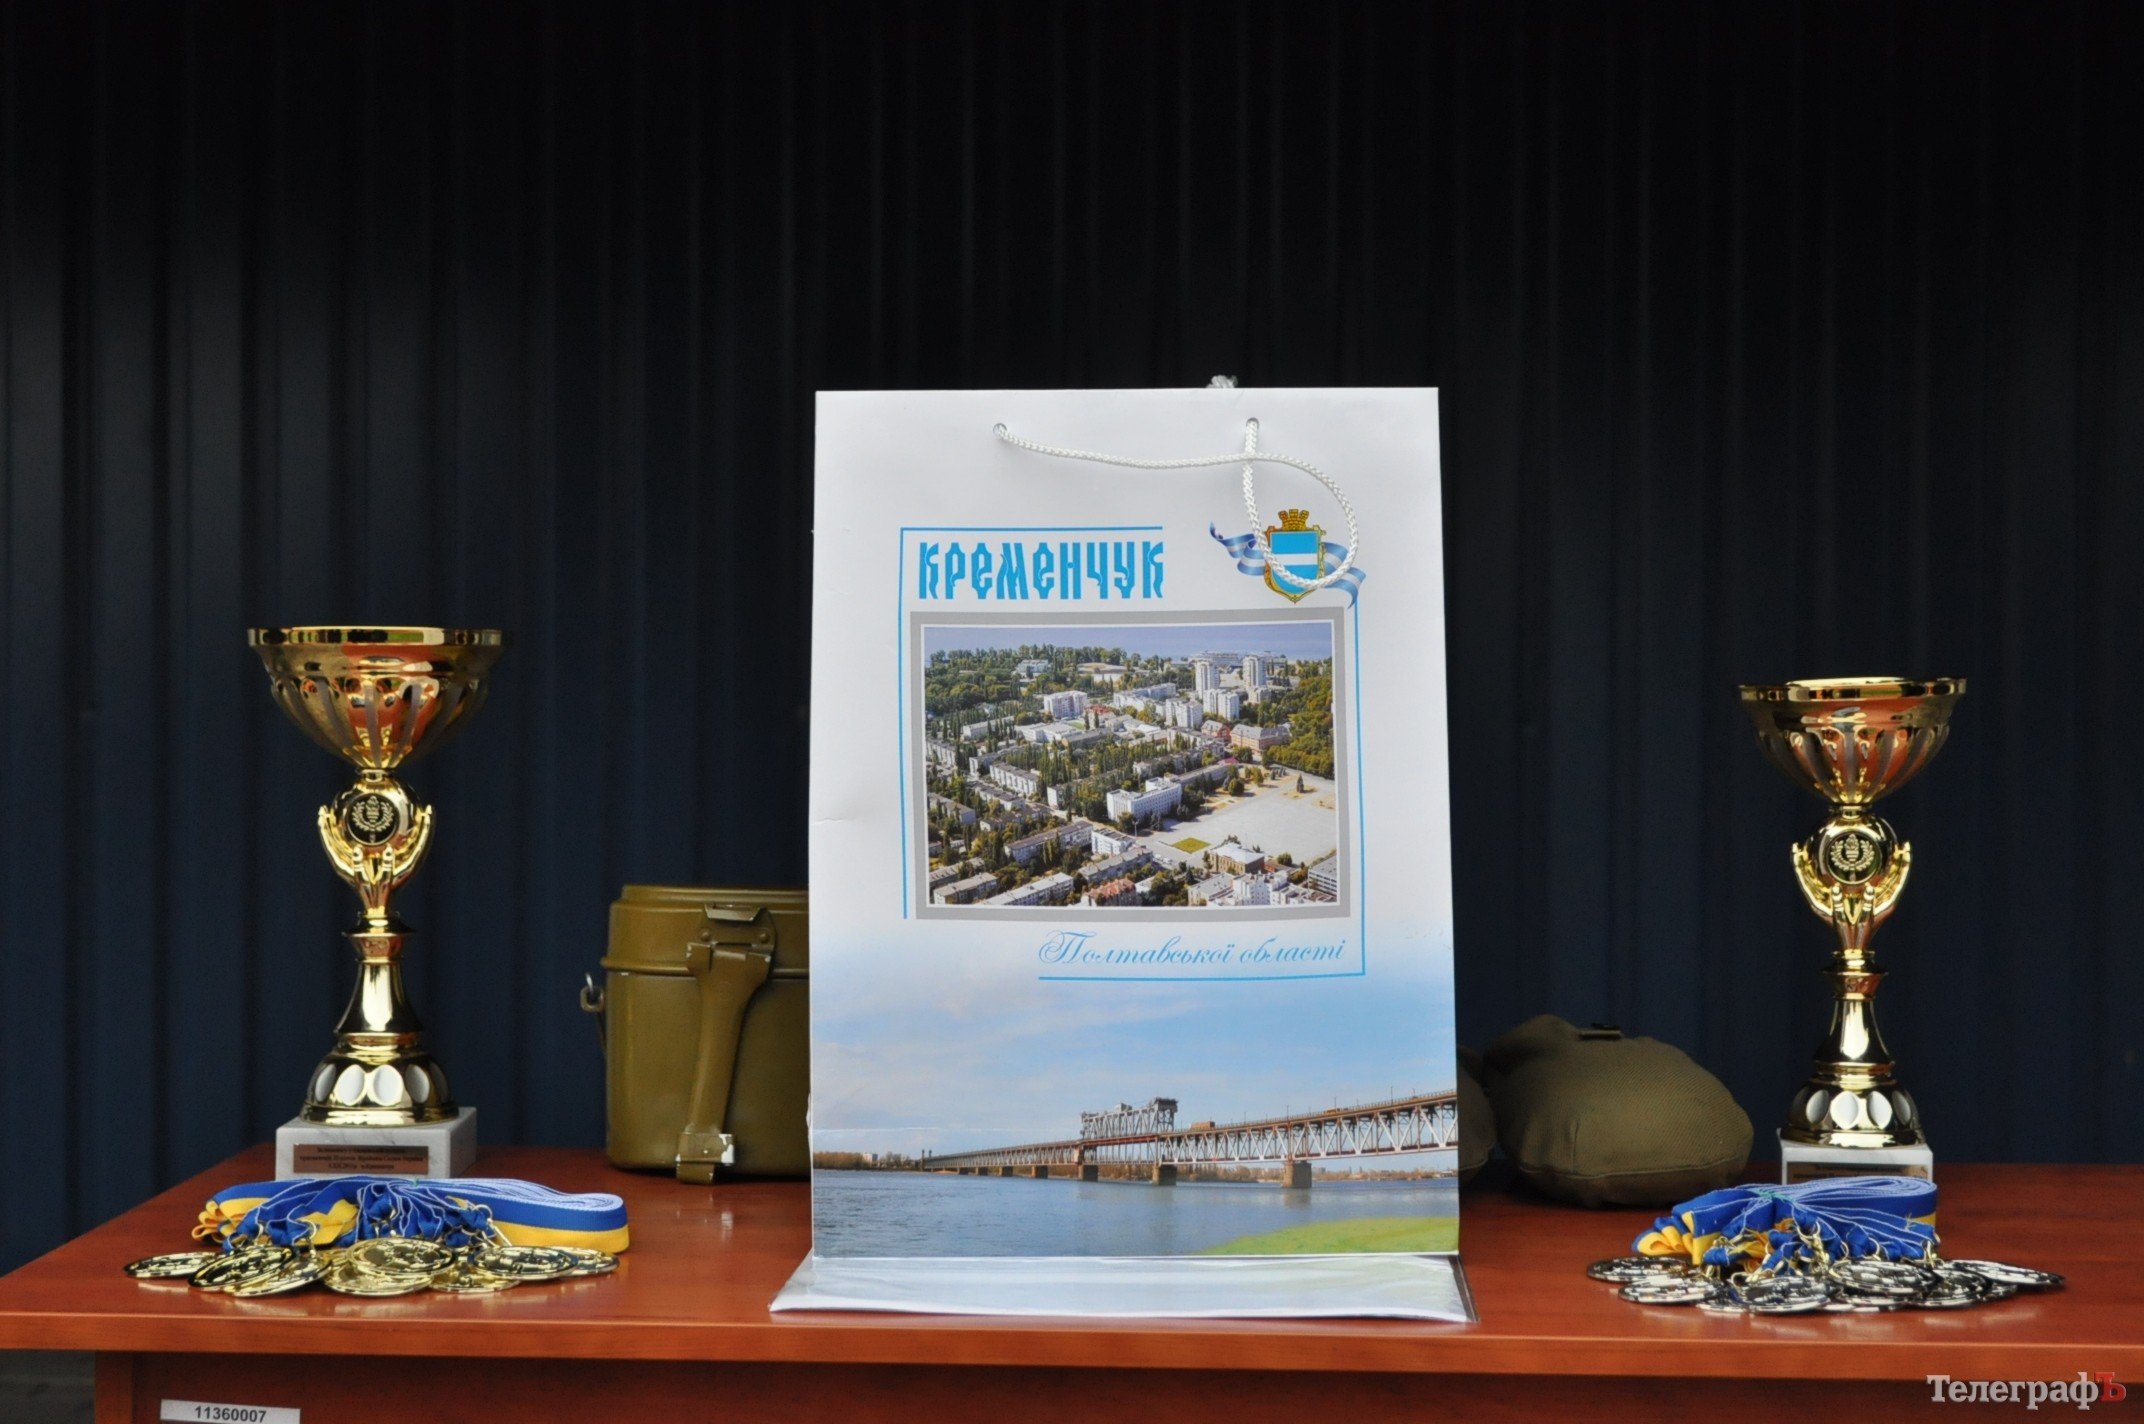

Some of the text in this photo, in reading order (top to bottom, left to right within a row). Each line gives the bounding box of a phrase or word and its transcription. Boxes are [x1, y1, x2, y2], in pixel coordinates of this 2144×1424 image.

[919, 541, 1164, 599] КРЕМЕНЧУК
[1039, 929, 1347, 964] Полтавської області
[194, 1406, 267, 1423] 11360007
